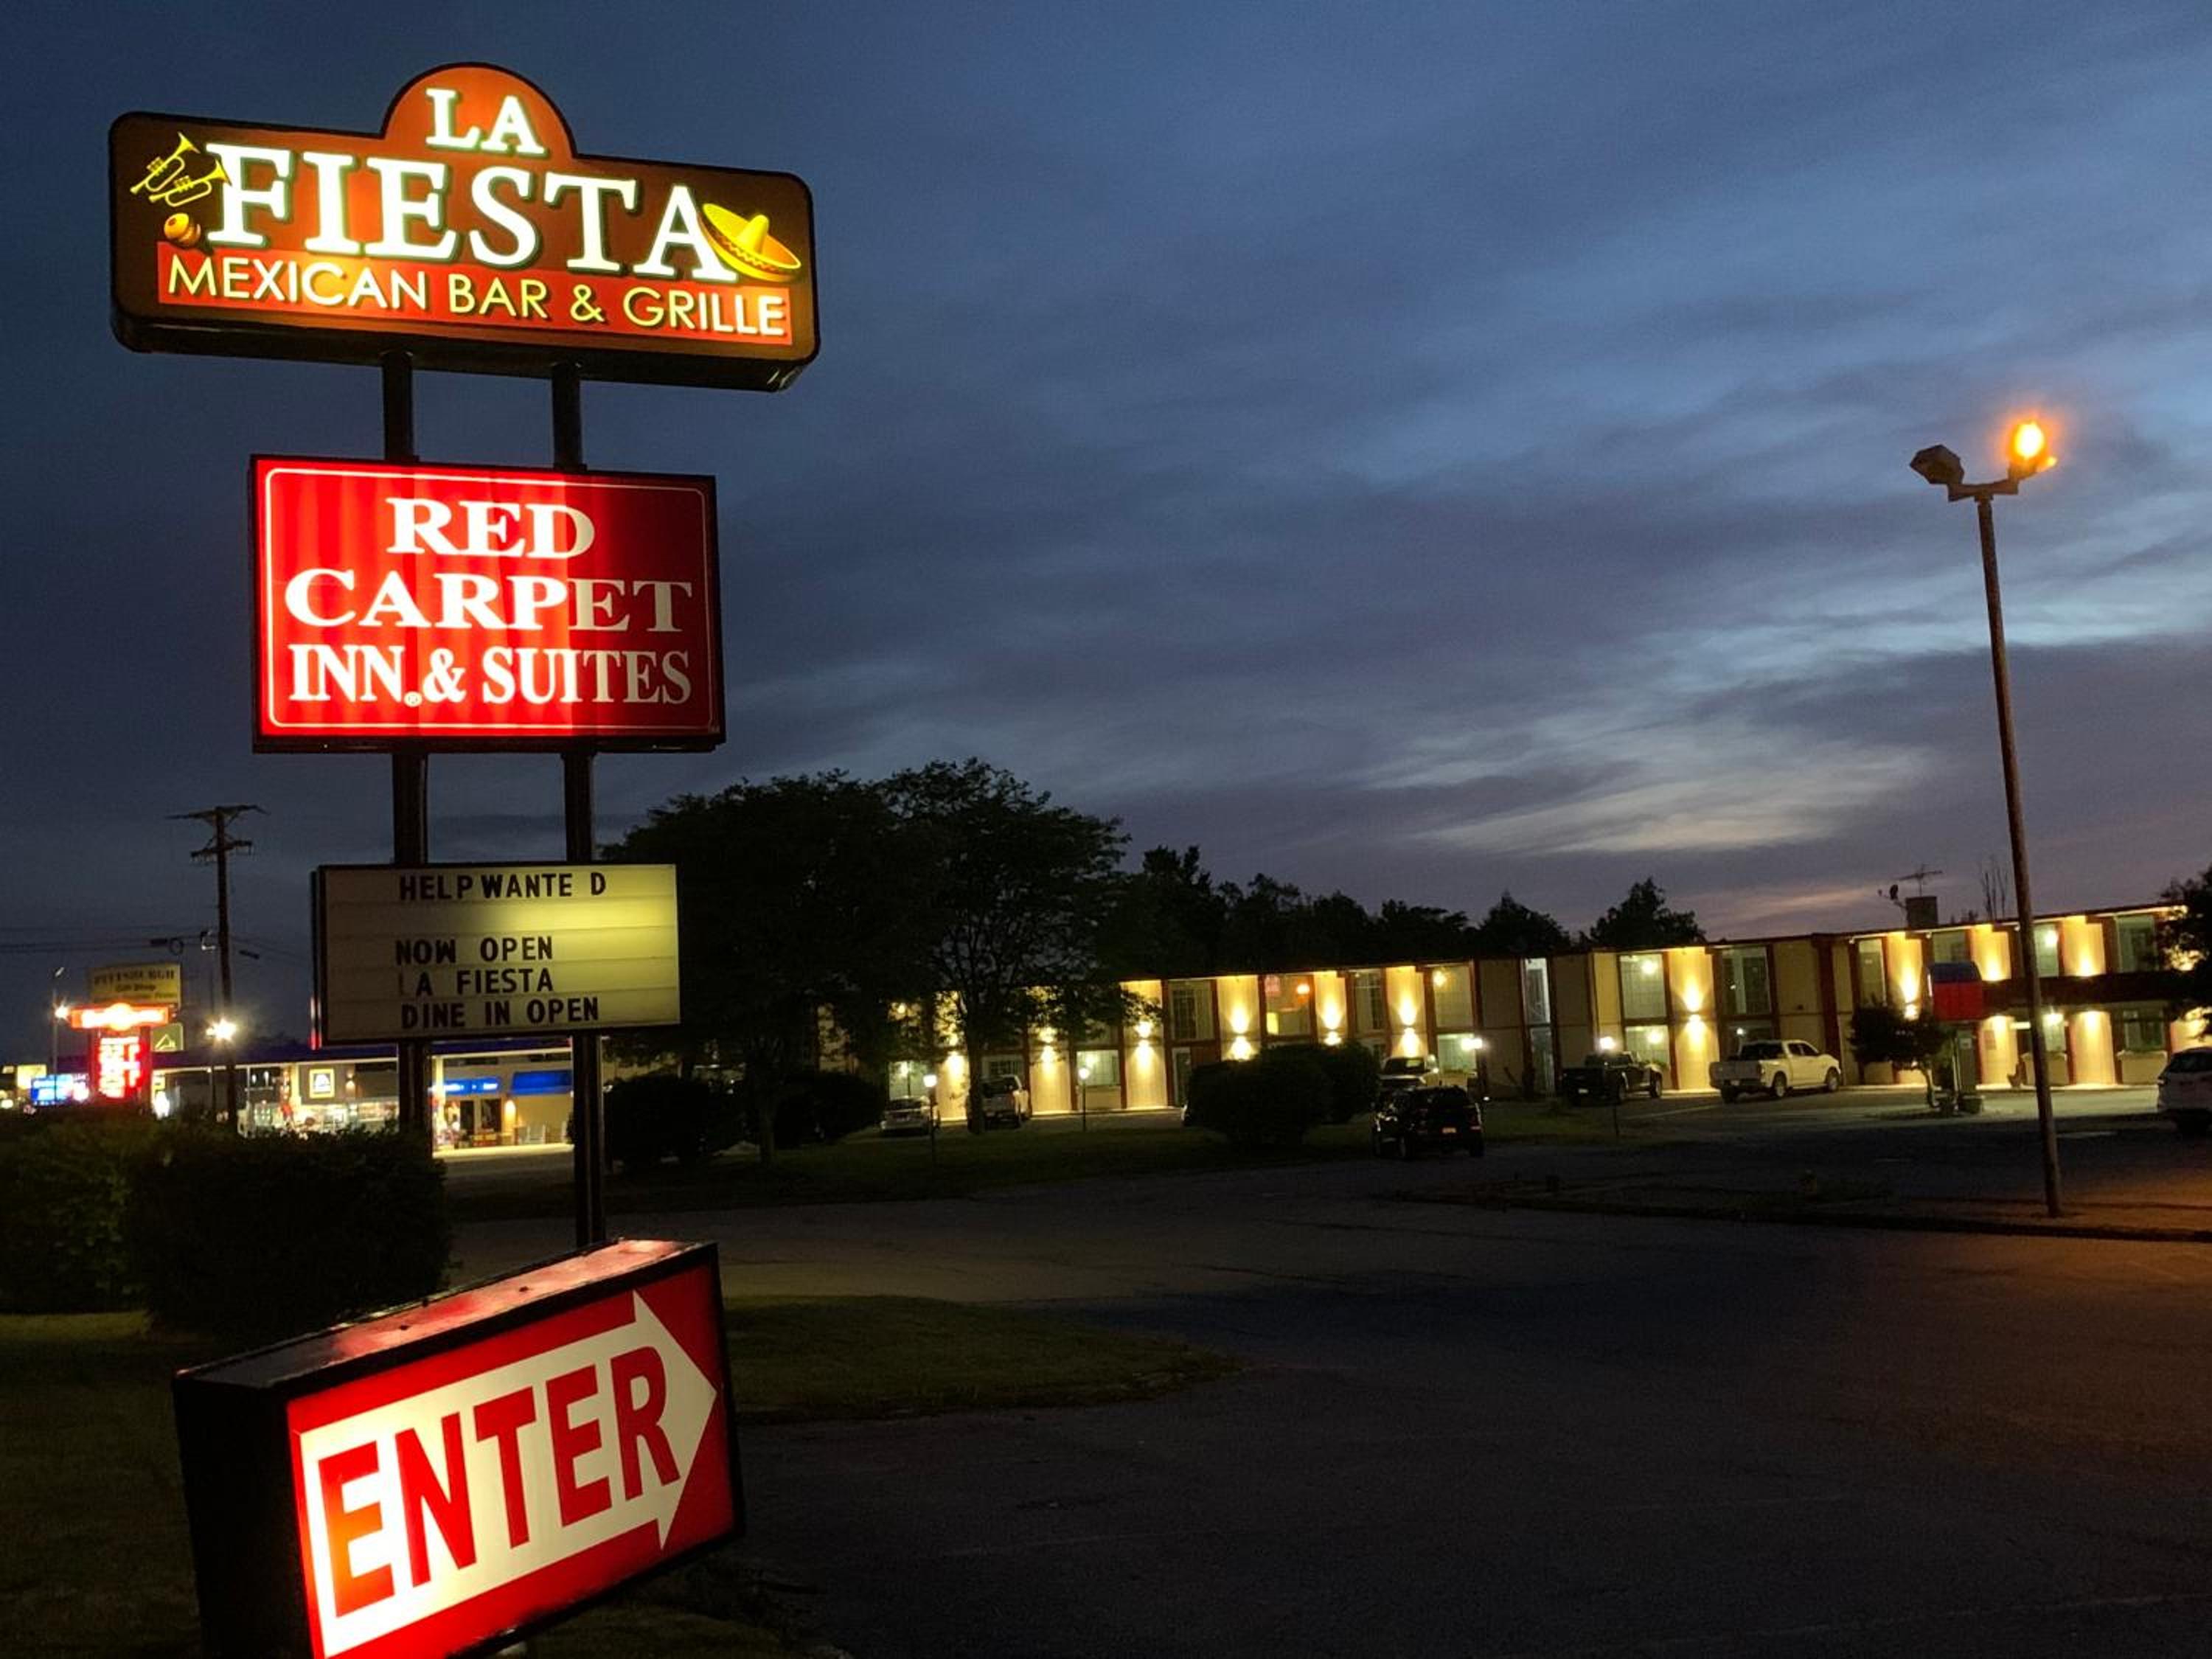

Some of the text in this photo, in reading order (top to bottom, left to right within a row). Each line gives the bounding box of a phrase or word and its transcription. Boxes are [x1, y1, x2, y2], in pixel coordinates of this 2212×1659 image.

[423, 87, 546, 157] LA
[205, 143, 738, 282] FIESTA
[167, 255, 787, 338] MEXICAN BAR & GRILLE
[386, 496, 596, 560] RED
[285, 567, 693, 633] CARPET
[422, 647, 467, 703] &
[482, 645, 692, 705] SUITES
[400, 874, 473, 901] HELP
[395, 936, 554, 965] NOW OPEN
[456, 967, 554, 995] FIESTA
[400, 996, 599, 1029] DINE IN OPEN
[318, 1346, 682, 1619] ENTER
